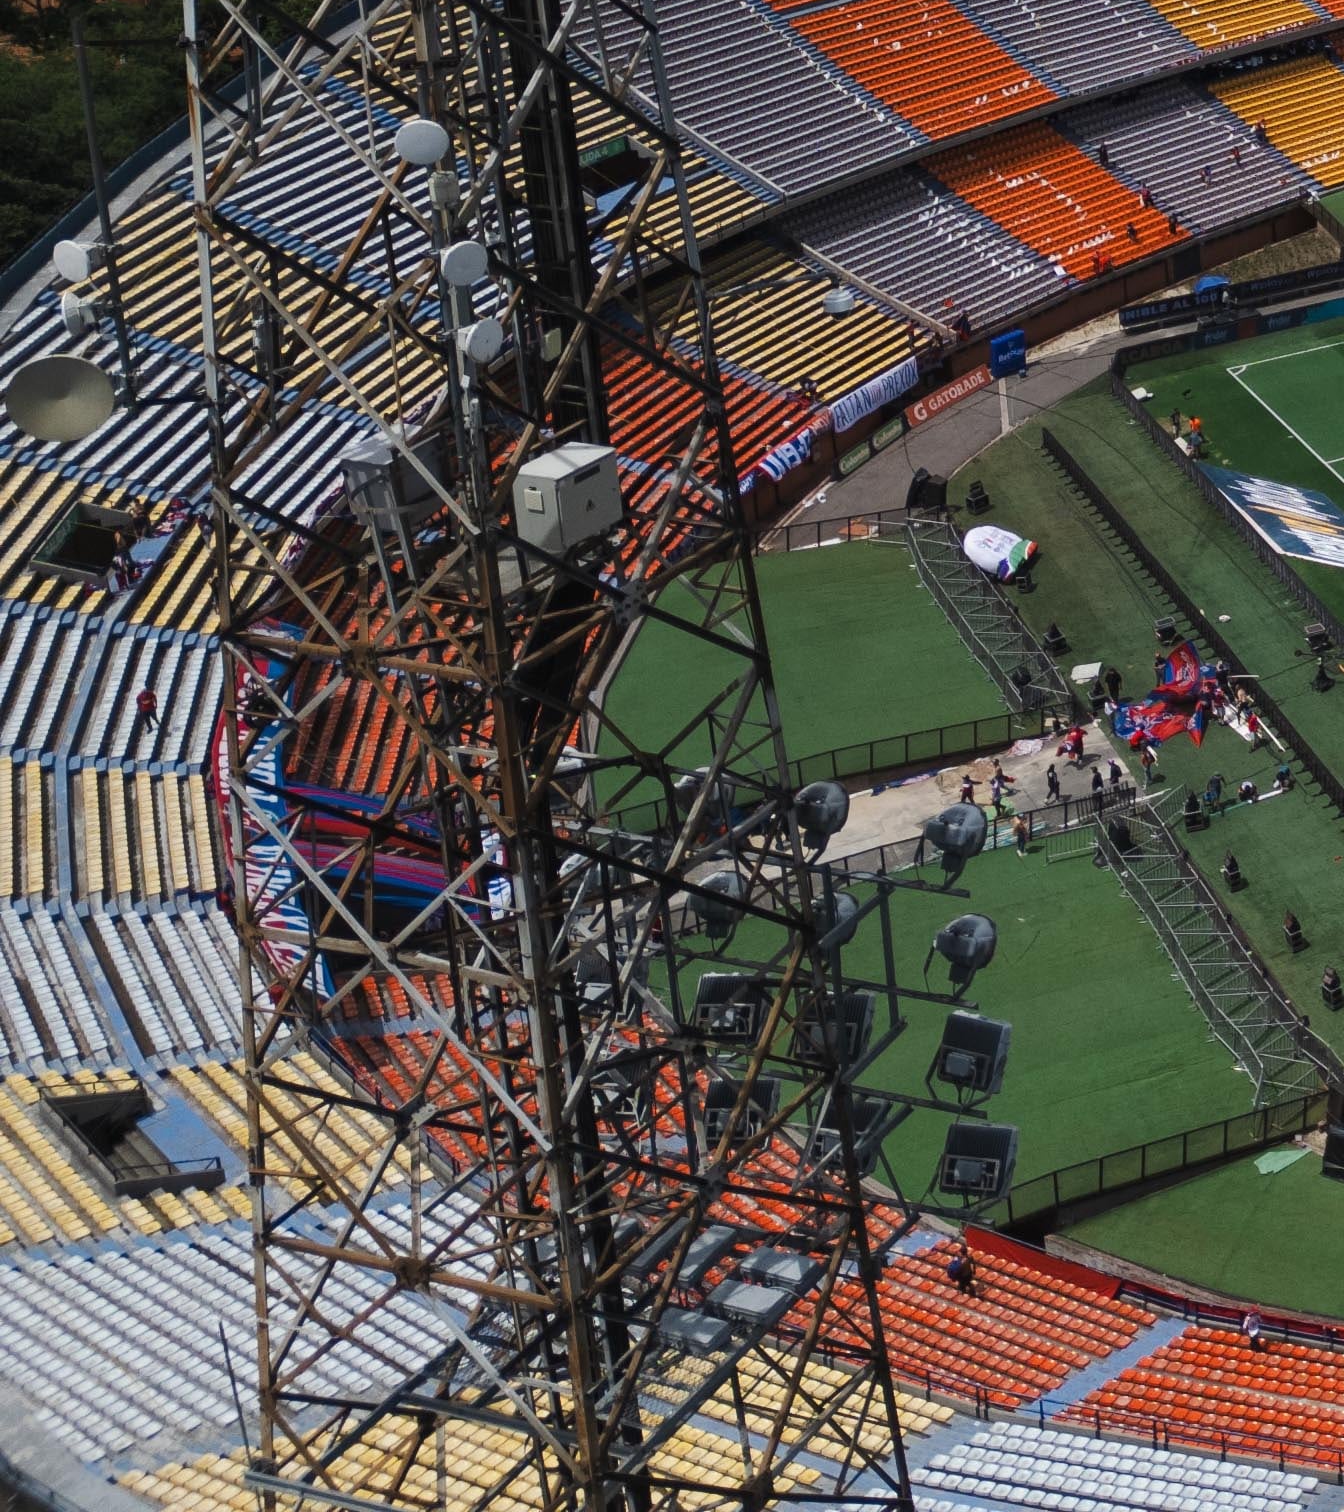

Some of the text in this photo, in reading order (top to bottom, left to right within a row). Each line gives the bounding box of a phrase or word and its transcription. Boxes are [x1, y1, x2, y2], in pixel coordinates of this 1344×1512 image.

[1172, 298, 1191, 311] AL
[913, 371, 986, 421] G GATORADE
